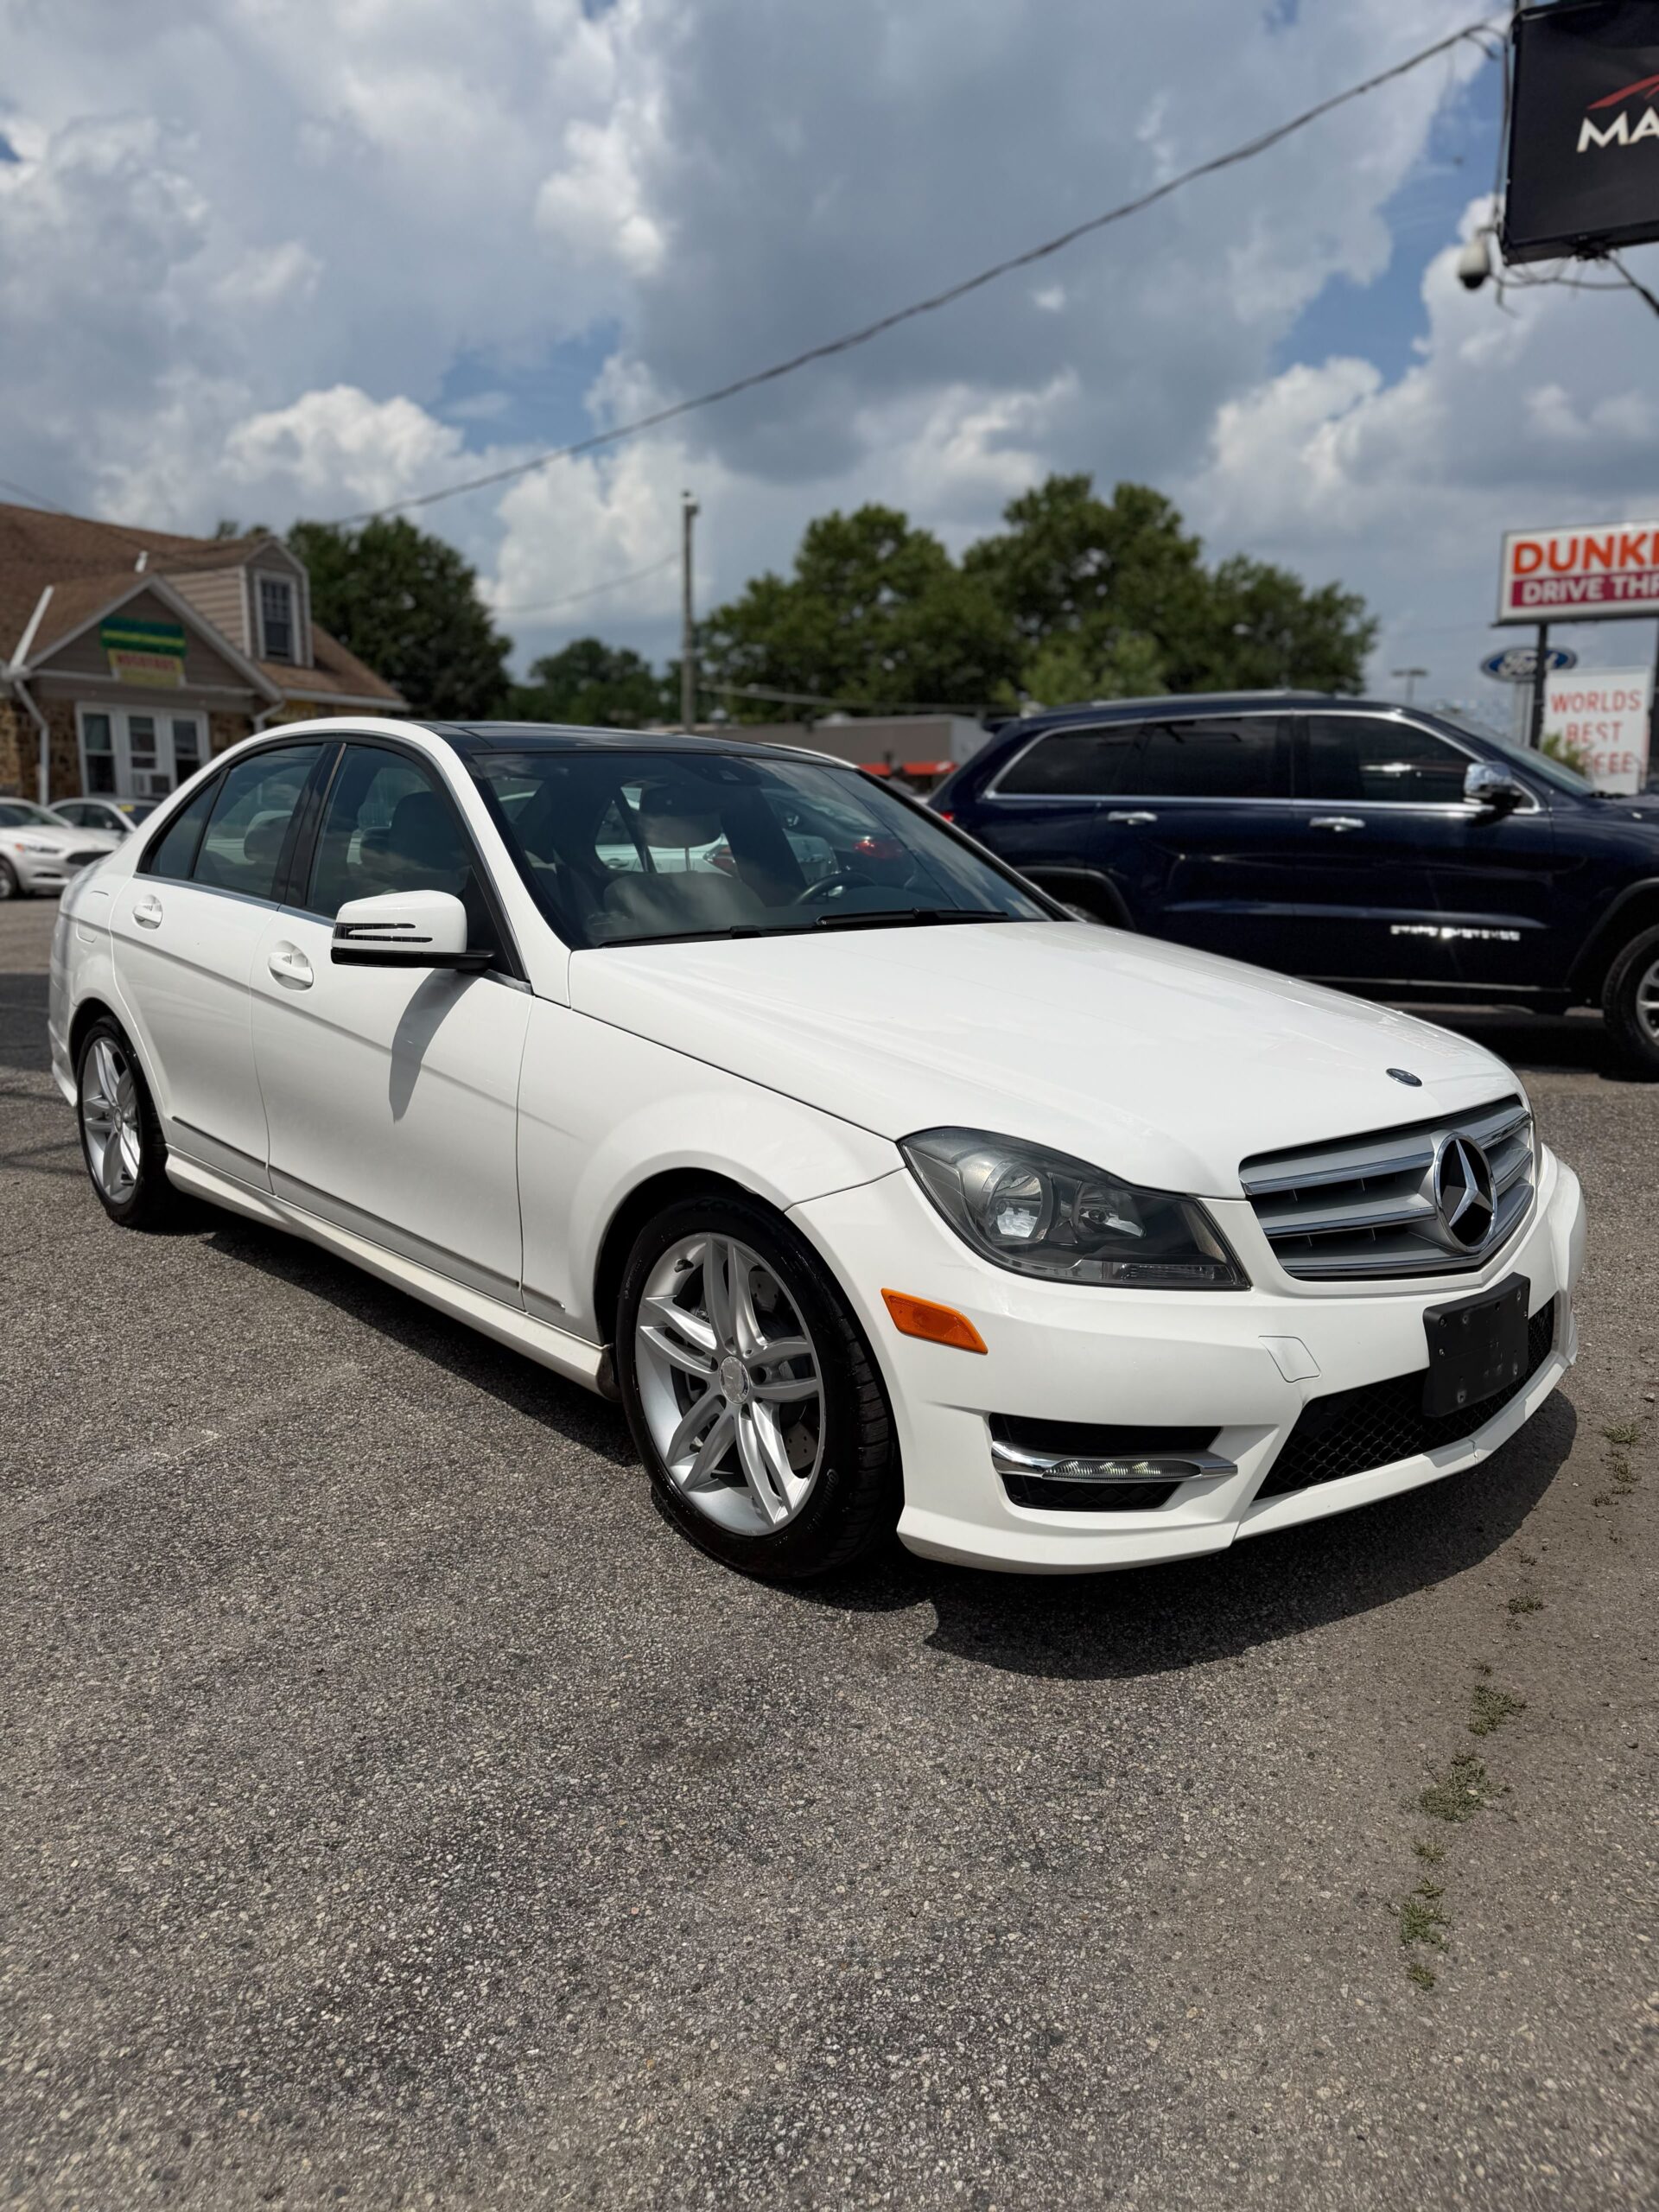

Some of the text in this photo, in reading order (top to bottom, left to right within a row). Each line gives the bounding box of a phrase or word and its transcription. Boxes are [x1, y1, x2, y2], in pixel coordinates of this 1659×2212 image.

[1576, 105, 1659, 153] MA
[1522, 576, 1605, 604] DRIVE
[1551, 690, 1641, 714] WORLDS
[1566, 721, 1622, 743] BEST
